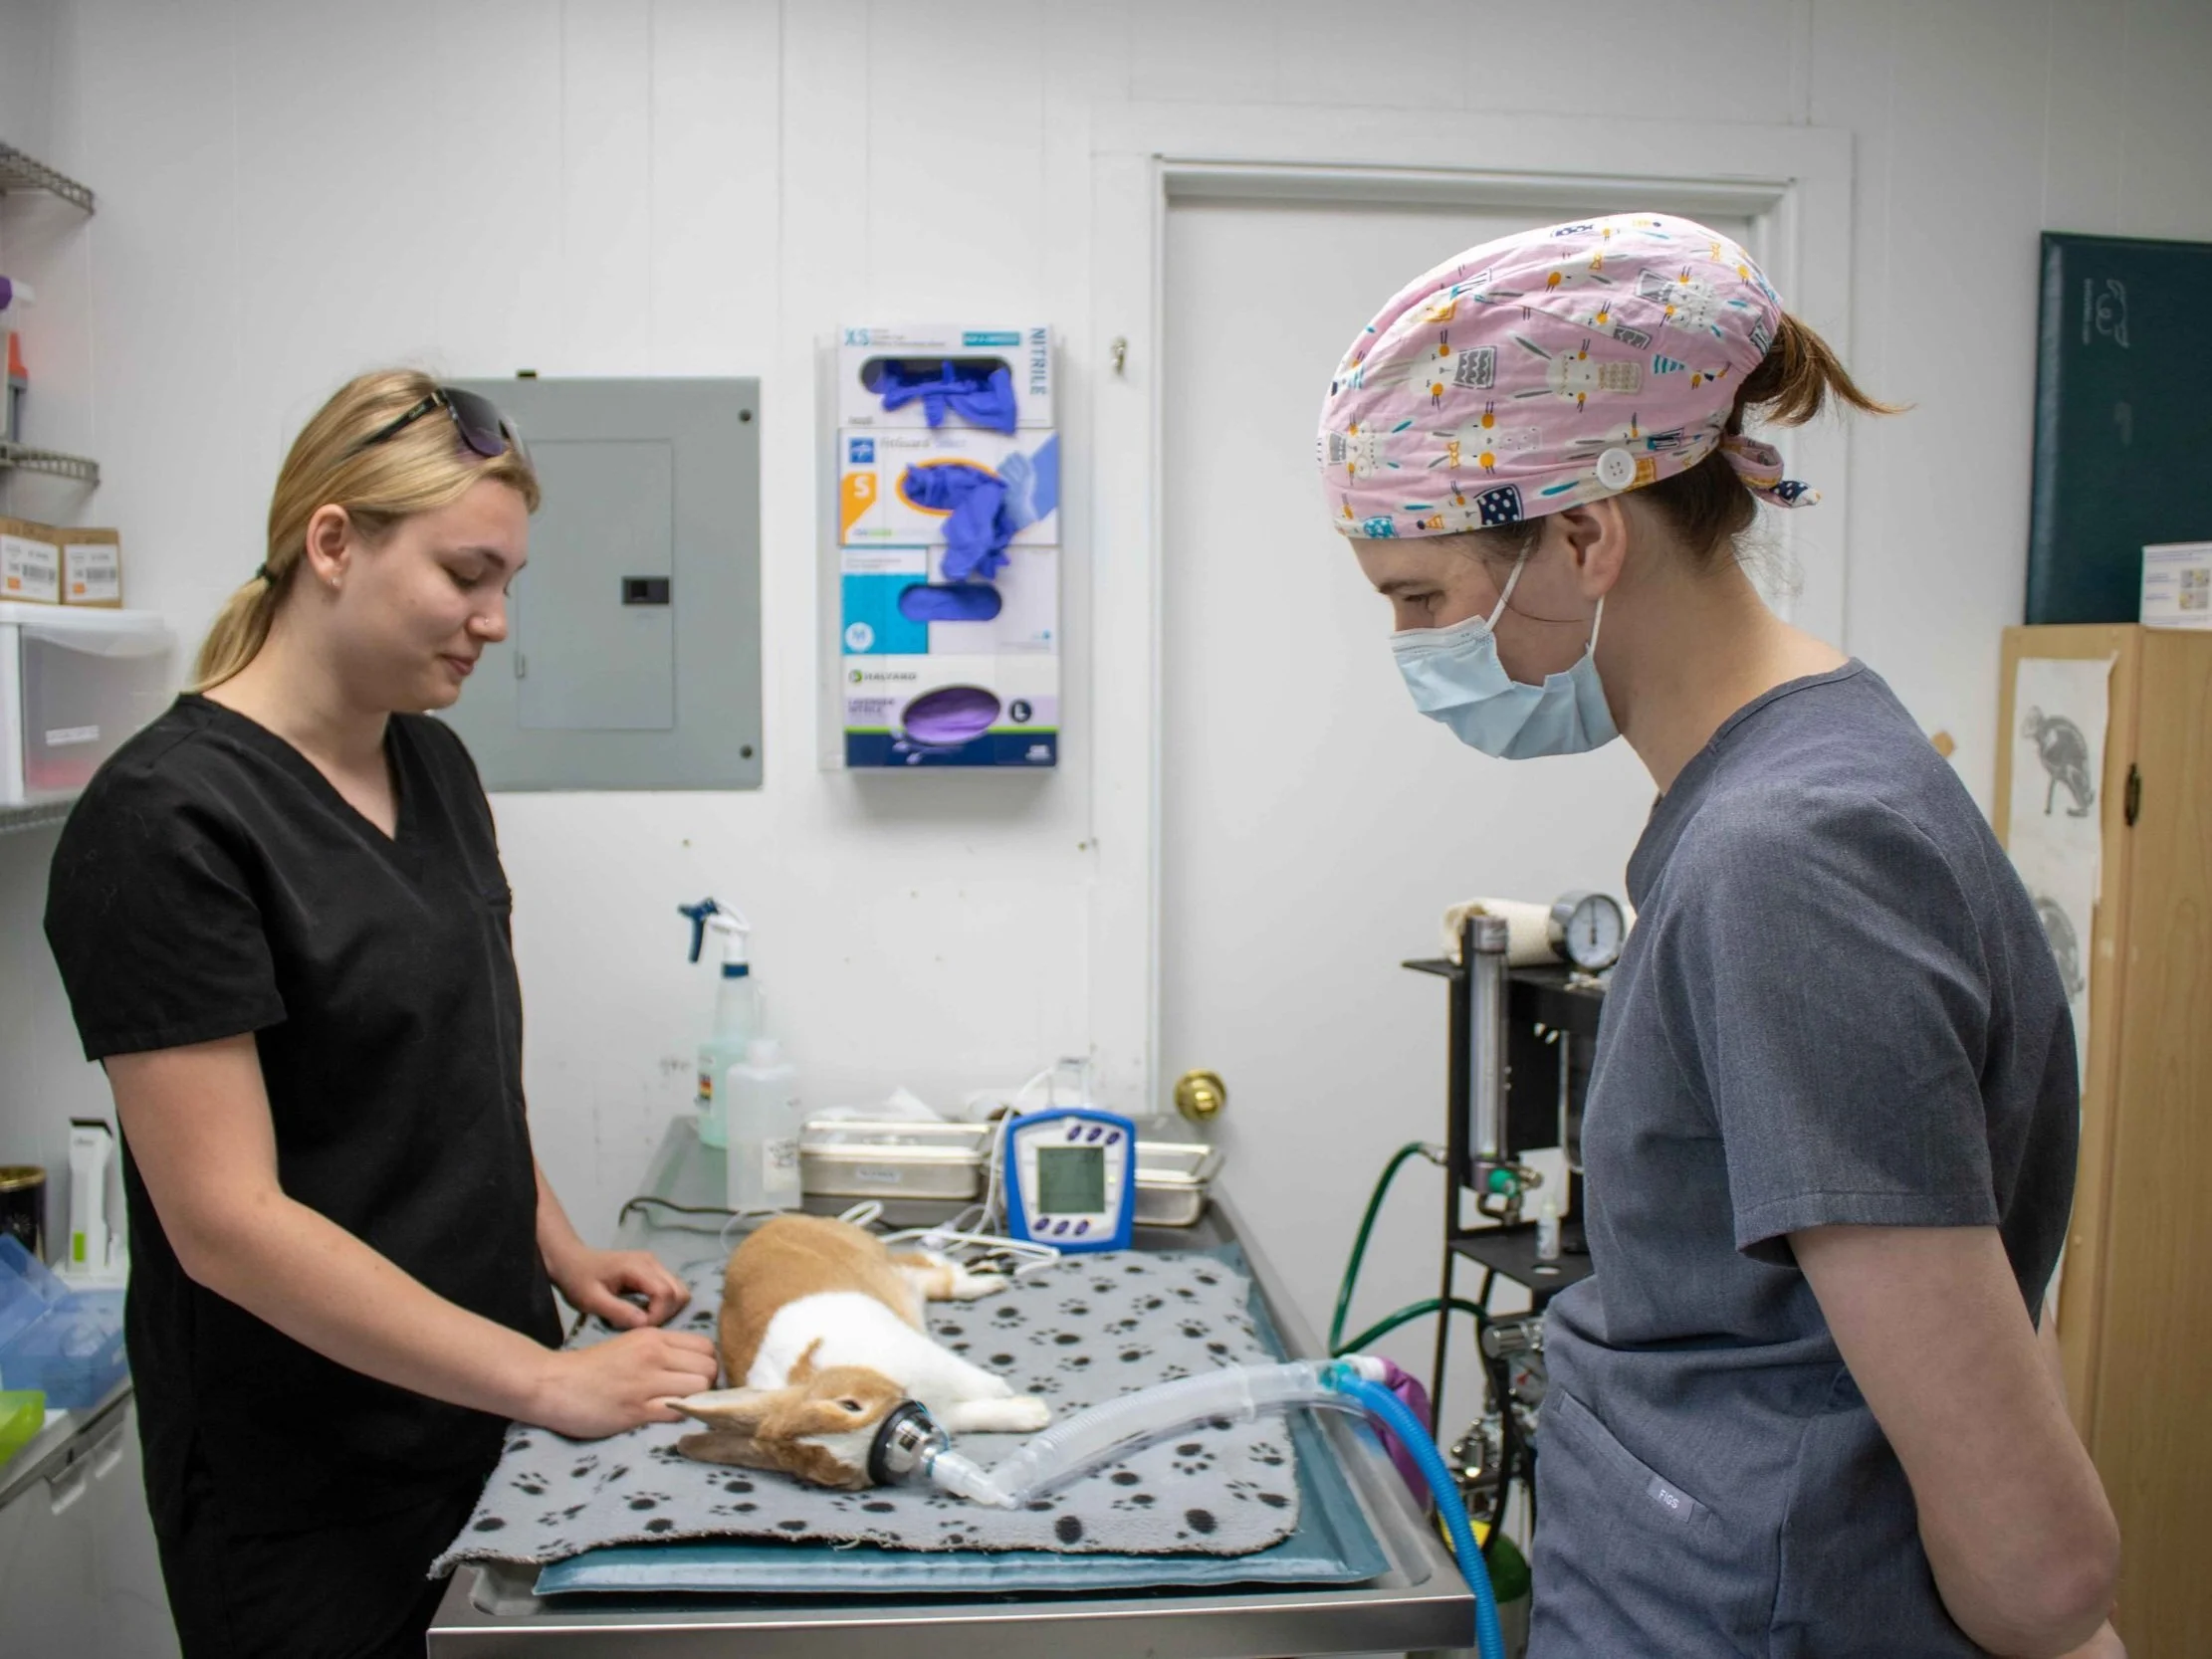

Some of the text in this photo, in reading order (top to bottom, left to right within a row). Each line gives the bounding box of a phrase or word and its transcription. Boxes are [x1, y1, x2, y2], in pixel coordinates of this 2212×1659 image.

[844, 327, 871, 346] XS
[1029, 327, 1046, 395] NITRILE
[854, 476, 870, 498] S
[1015, 705, 1027, 722] L
[1659, 1489, 1679, 1509] FIGS
